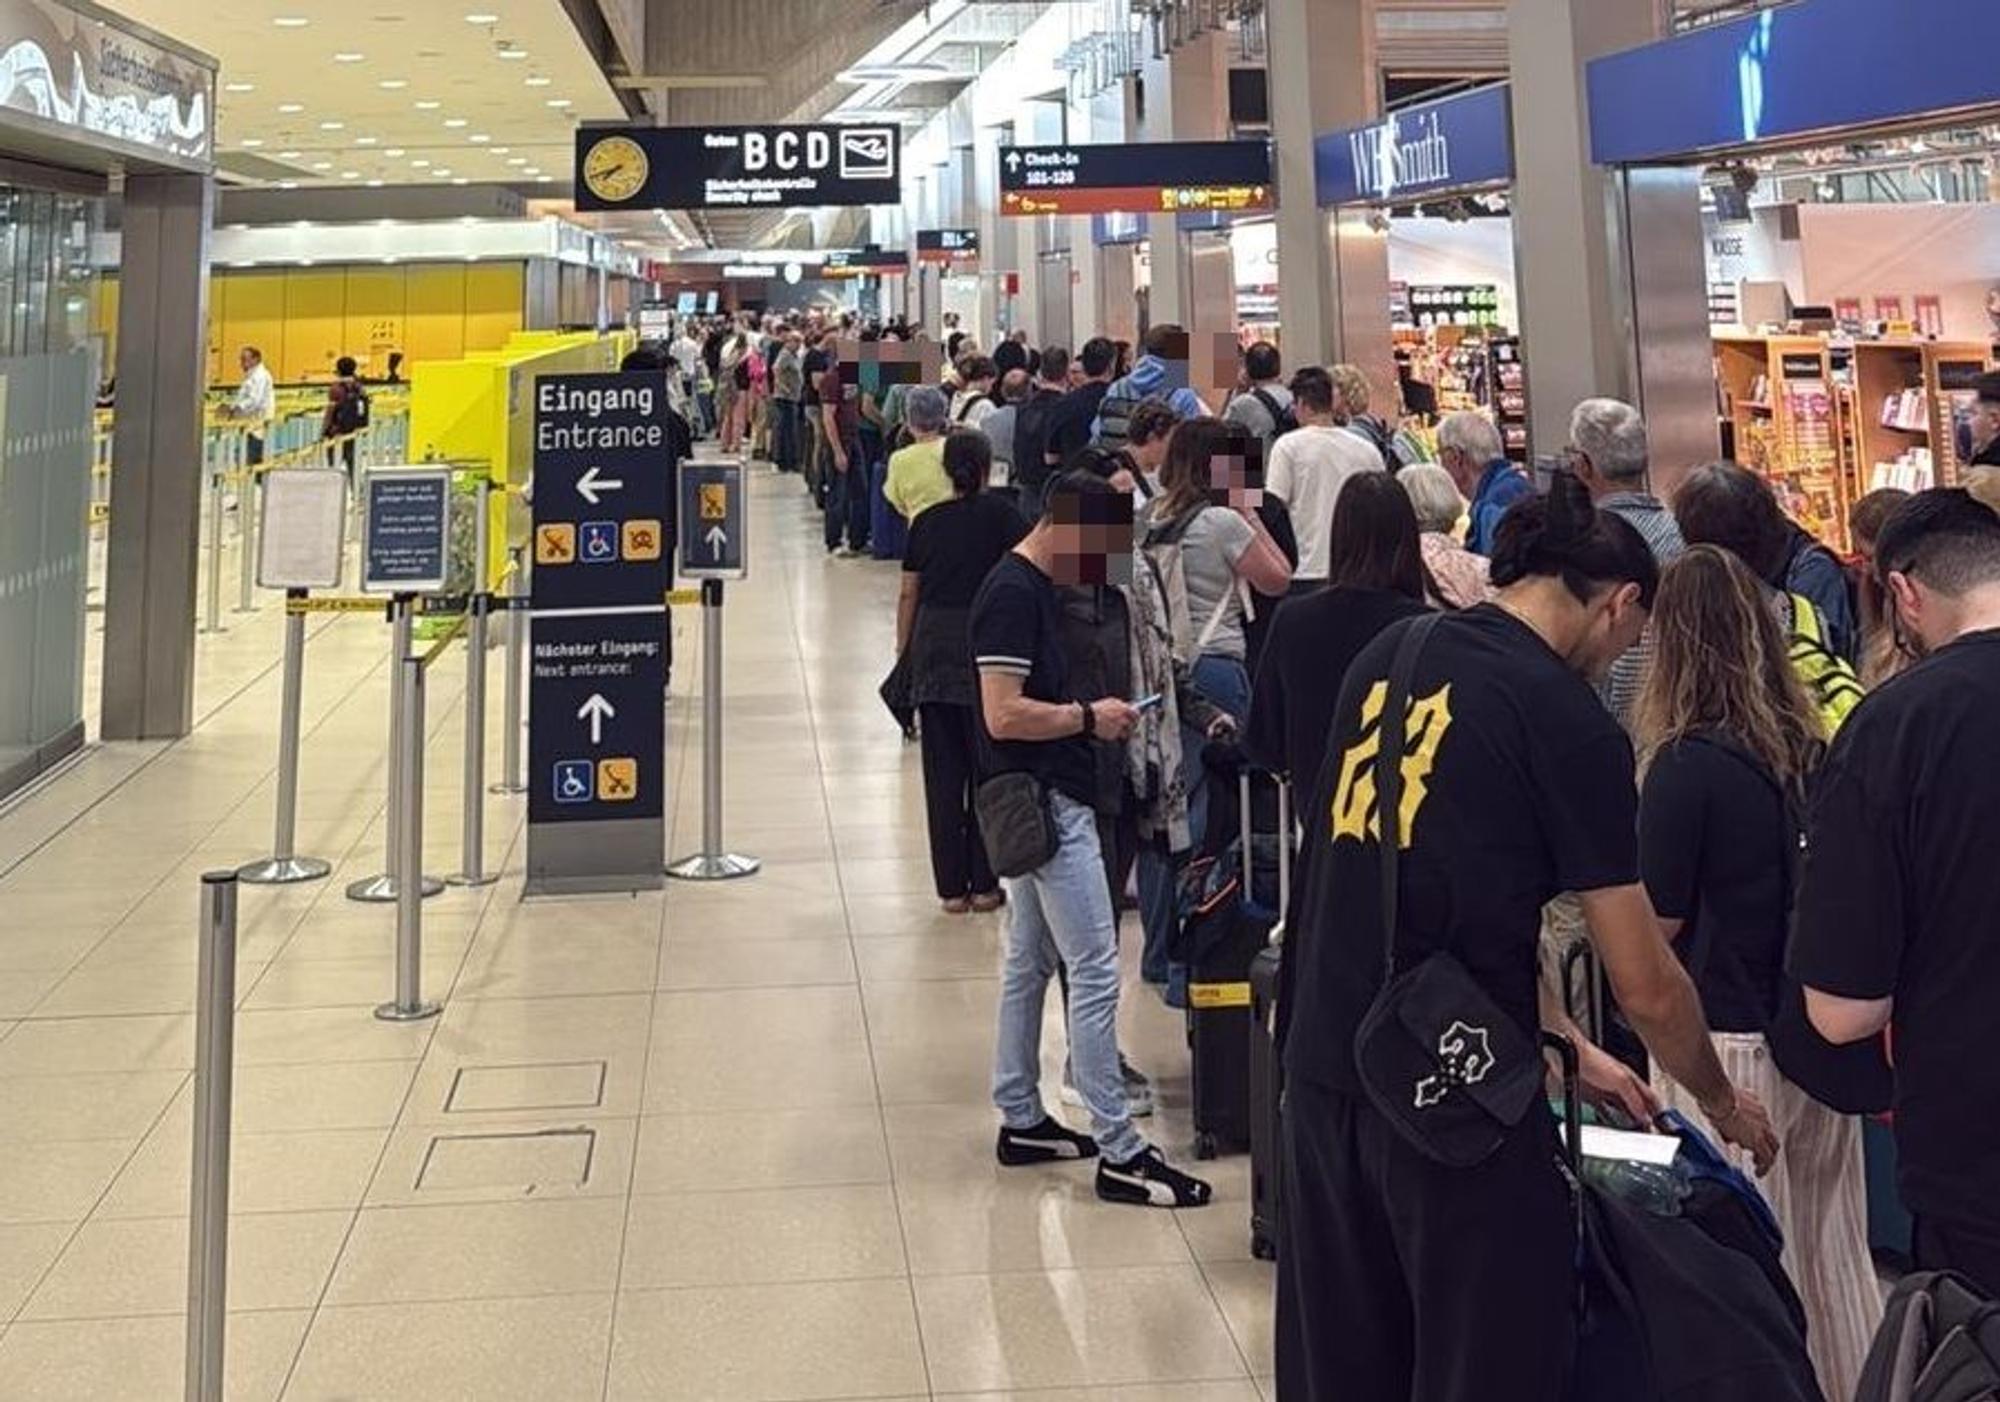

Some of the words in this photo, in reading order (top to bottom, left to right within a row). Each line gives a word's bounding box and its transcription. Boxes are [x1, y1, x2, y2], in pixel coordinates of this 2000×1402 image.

[1349, 112, 1450, 195] WHSmith
[538, 385, 654, 417] Eingang
[537, 422, 663, 451] Entrance
[535, 642, 596, 659] Nächster
[601, 640, 660, 657] Eingang:
[535, 664, 567, 677] Next
